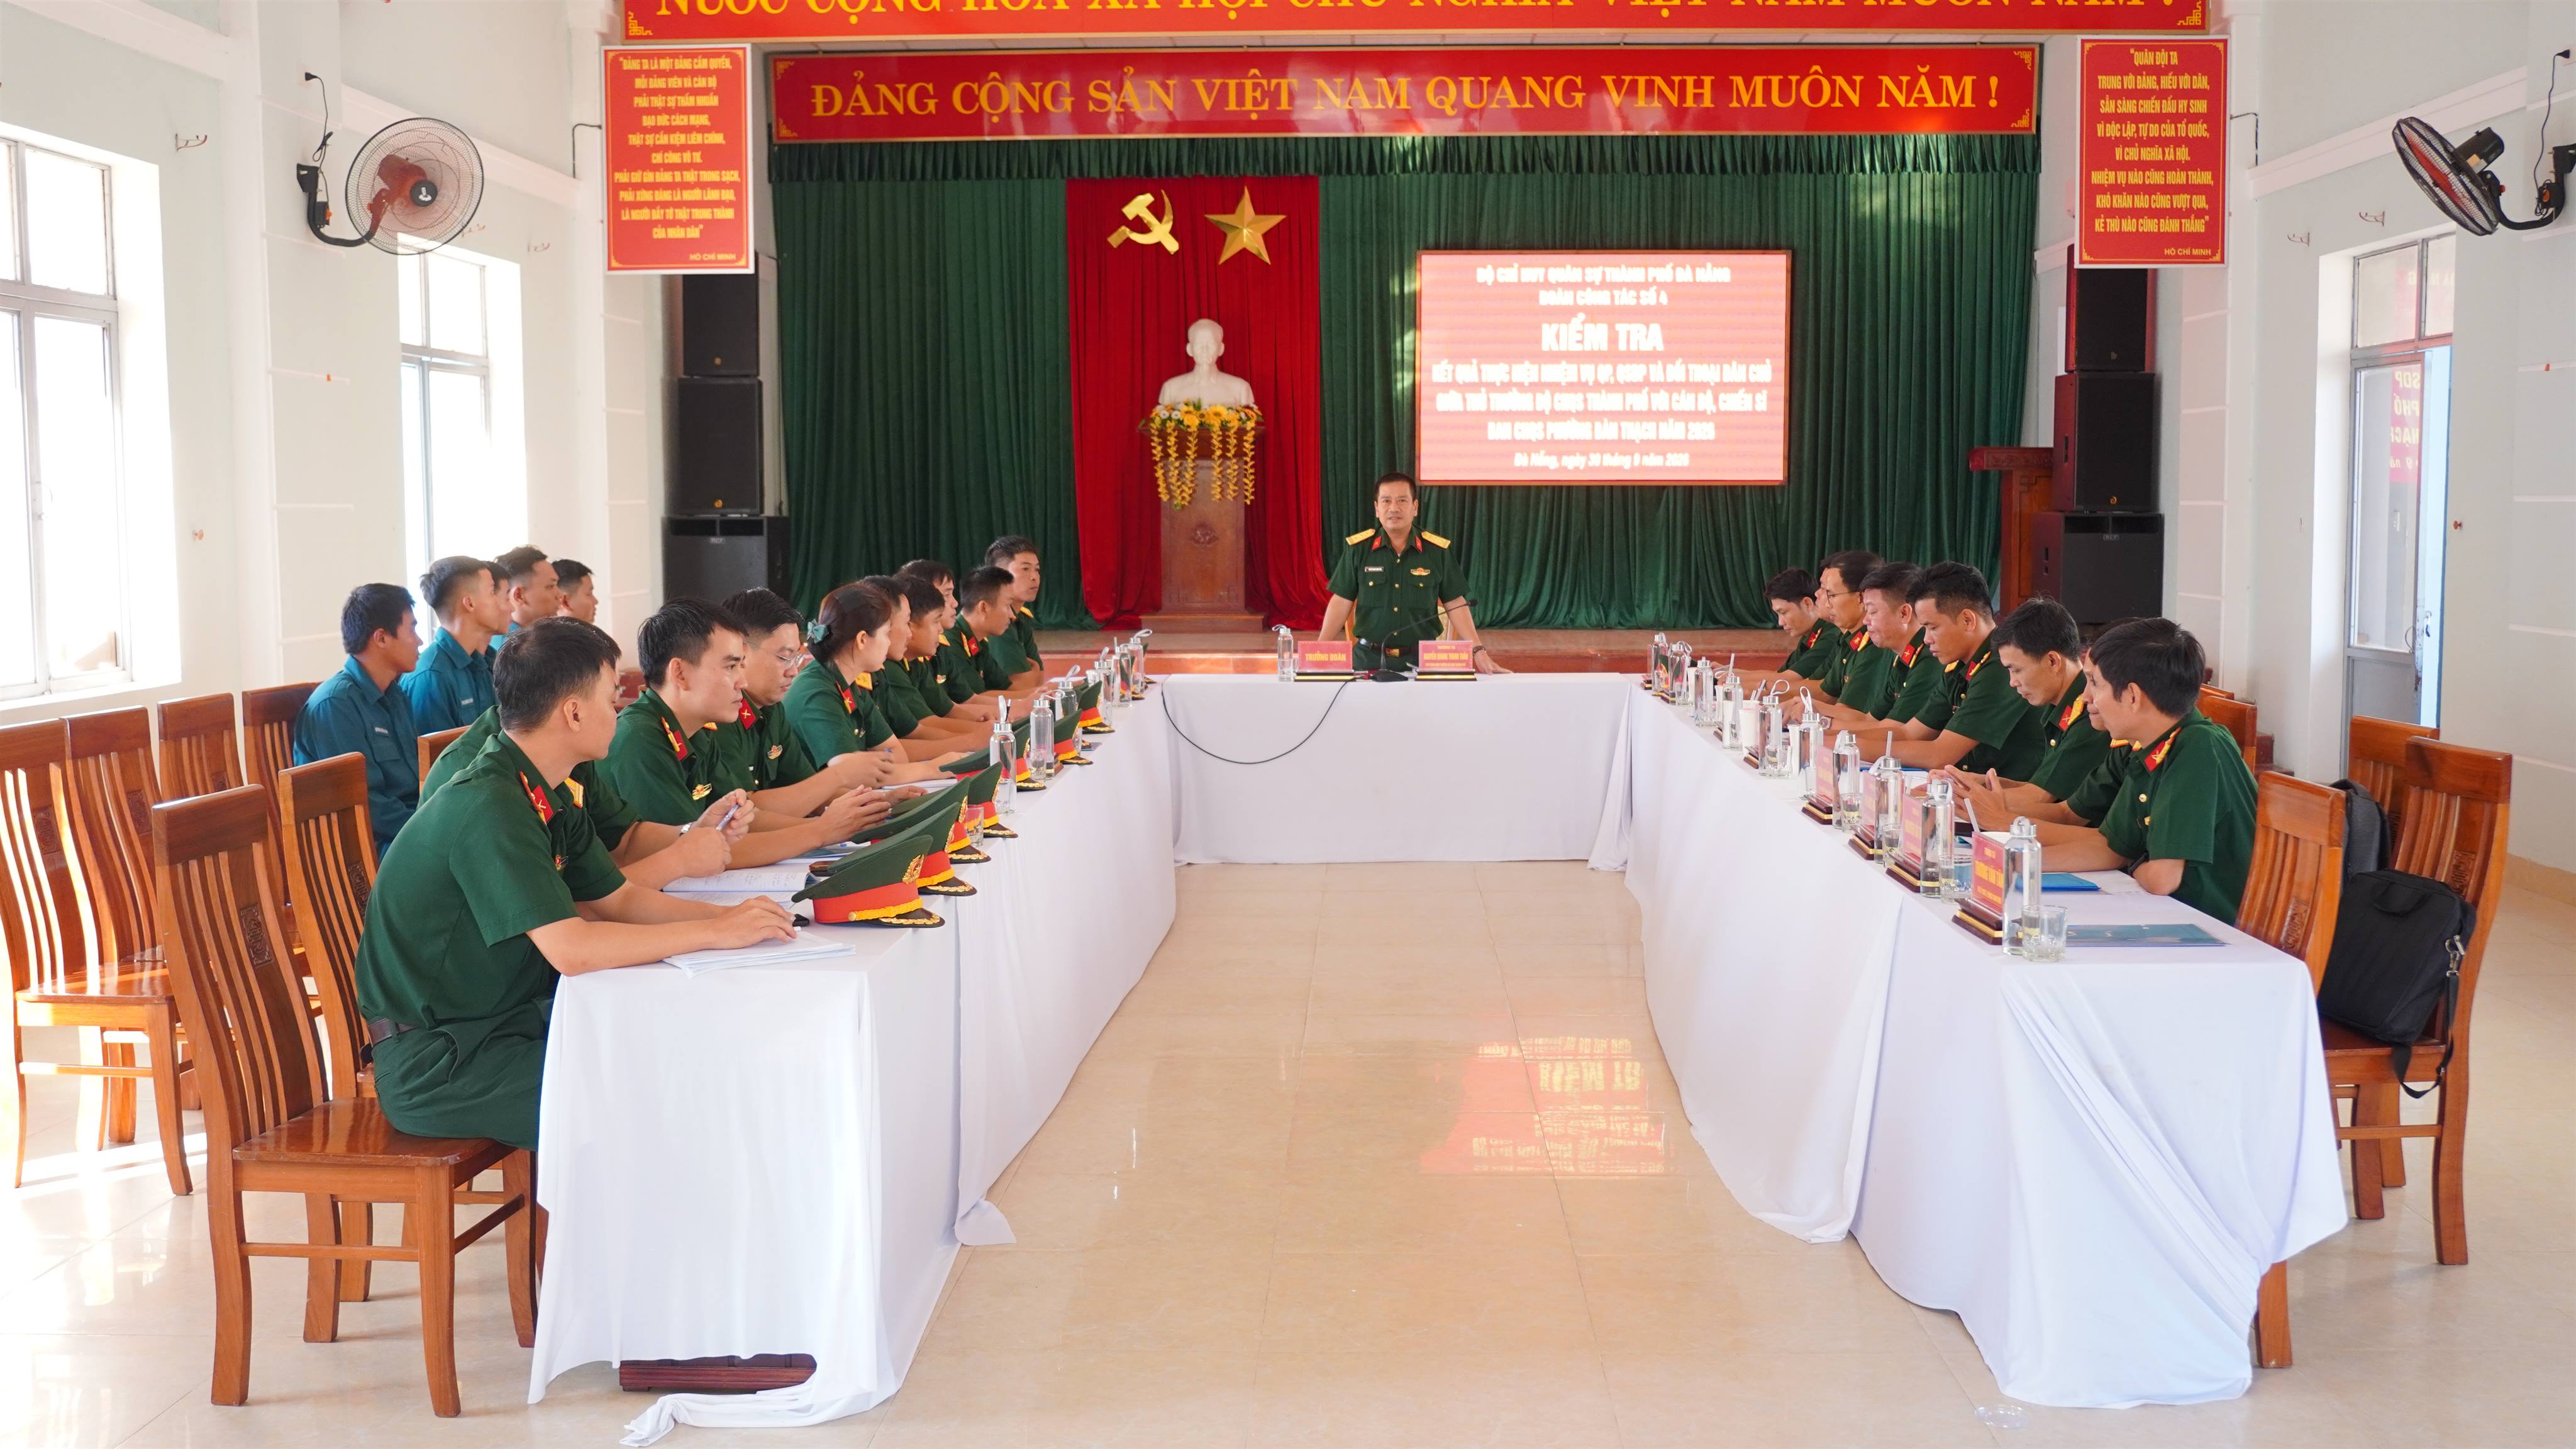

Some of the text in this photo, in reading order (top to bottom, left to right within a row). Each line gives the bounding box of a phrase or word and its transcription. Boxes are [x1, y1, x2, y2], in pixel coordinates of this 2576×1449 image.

[2130, 48, 2178, 67] "QUÂN ĐỘI TA
[2098, 72, 2209, 90] TRUNG VỚI ĐẢNG, HIẾU VỚI DÂN,
[811, 64, 1999, 123] ĐẢNG CỘNG SẢN VIỆT NAM QUANG VINH MUÔN NĂM !
[2117, 97, 2136, 113] SÀNG
[2138, 96, 2160, 113] CHIẾN
[2162, 96, 2177, 113] ĐẤU
[2179, 100, 2188, 113] HY
[2190, 100, 2207, 113] SINH
[2097, 119, 2209, 140] VÌ ĐỘC LẬP, TỰ DO CỦA TỔ QUỐC,
[2116, 143, 2190, 164] VÌ CHỦ NGHĨA XÃ HỘI.
[2092, 169, 2213, 187] NHIỆM VỤ NÀO CŨNG HOÀN THÀNH,
[2096, 192, 2208, 211] KHÓ KHĂN NÀO CŨNG VƯỢT QUA,
[2095, 214, 2104, 231] KẺ
[2106, 216, 2120, 231] THÙ
[2122, 216, 2136, 231] NÀO
[2138, 216, 2158, 232] CŨNG
[2160, 216, 2180, 232] ĐÁNH
[2178, 247, 2190, 255] CHÍ
[1614, 288, 1636, 305] TÁC
[1640, 286, 1657, 305] SỐ
[1660, 291, 1667, 305] 4
[1542, 313, 1663, 350] KIỂM TRA
[1305, 651, 1346, 662] TRƯỞNG ĐOÀN
